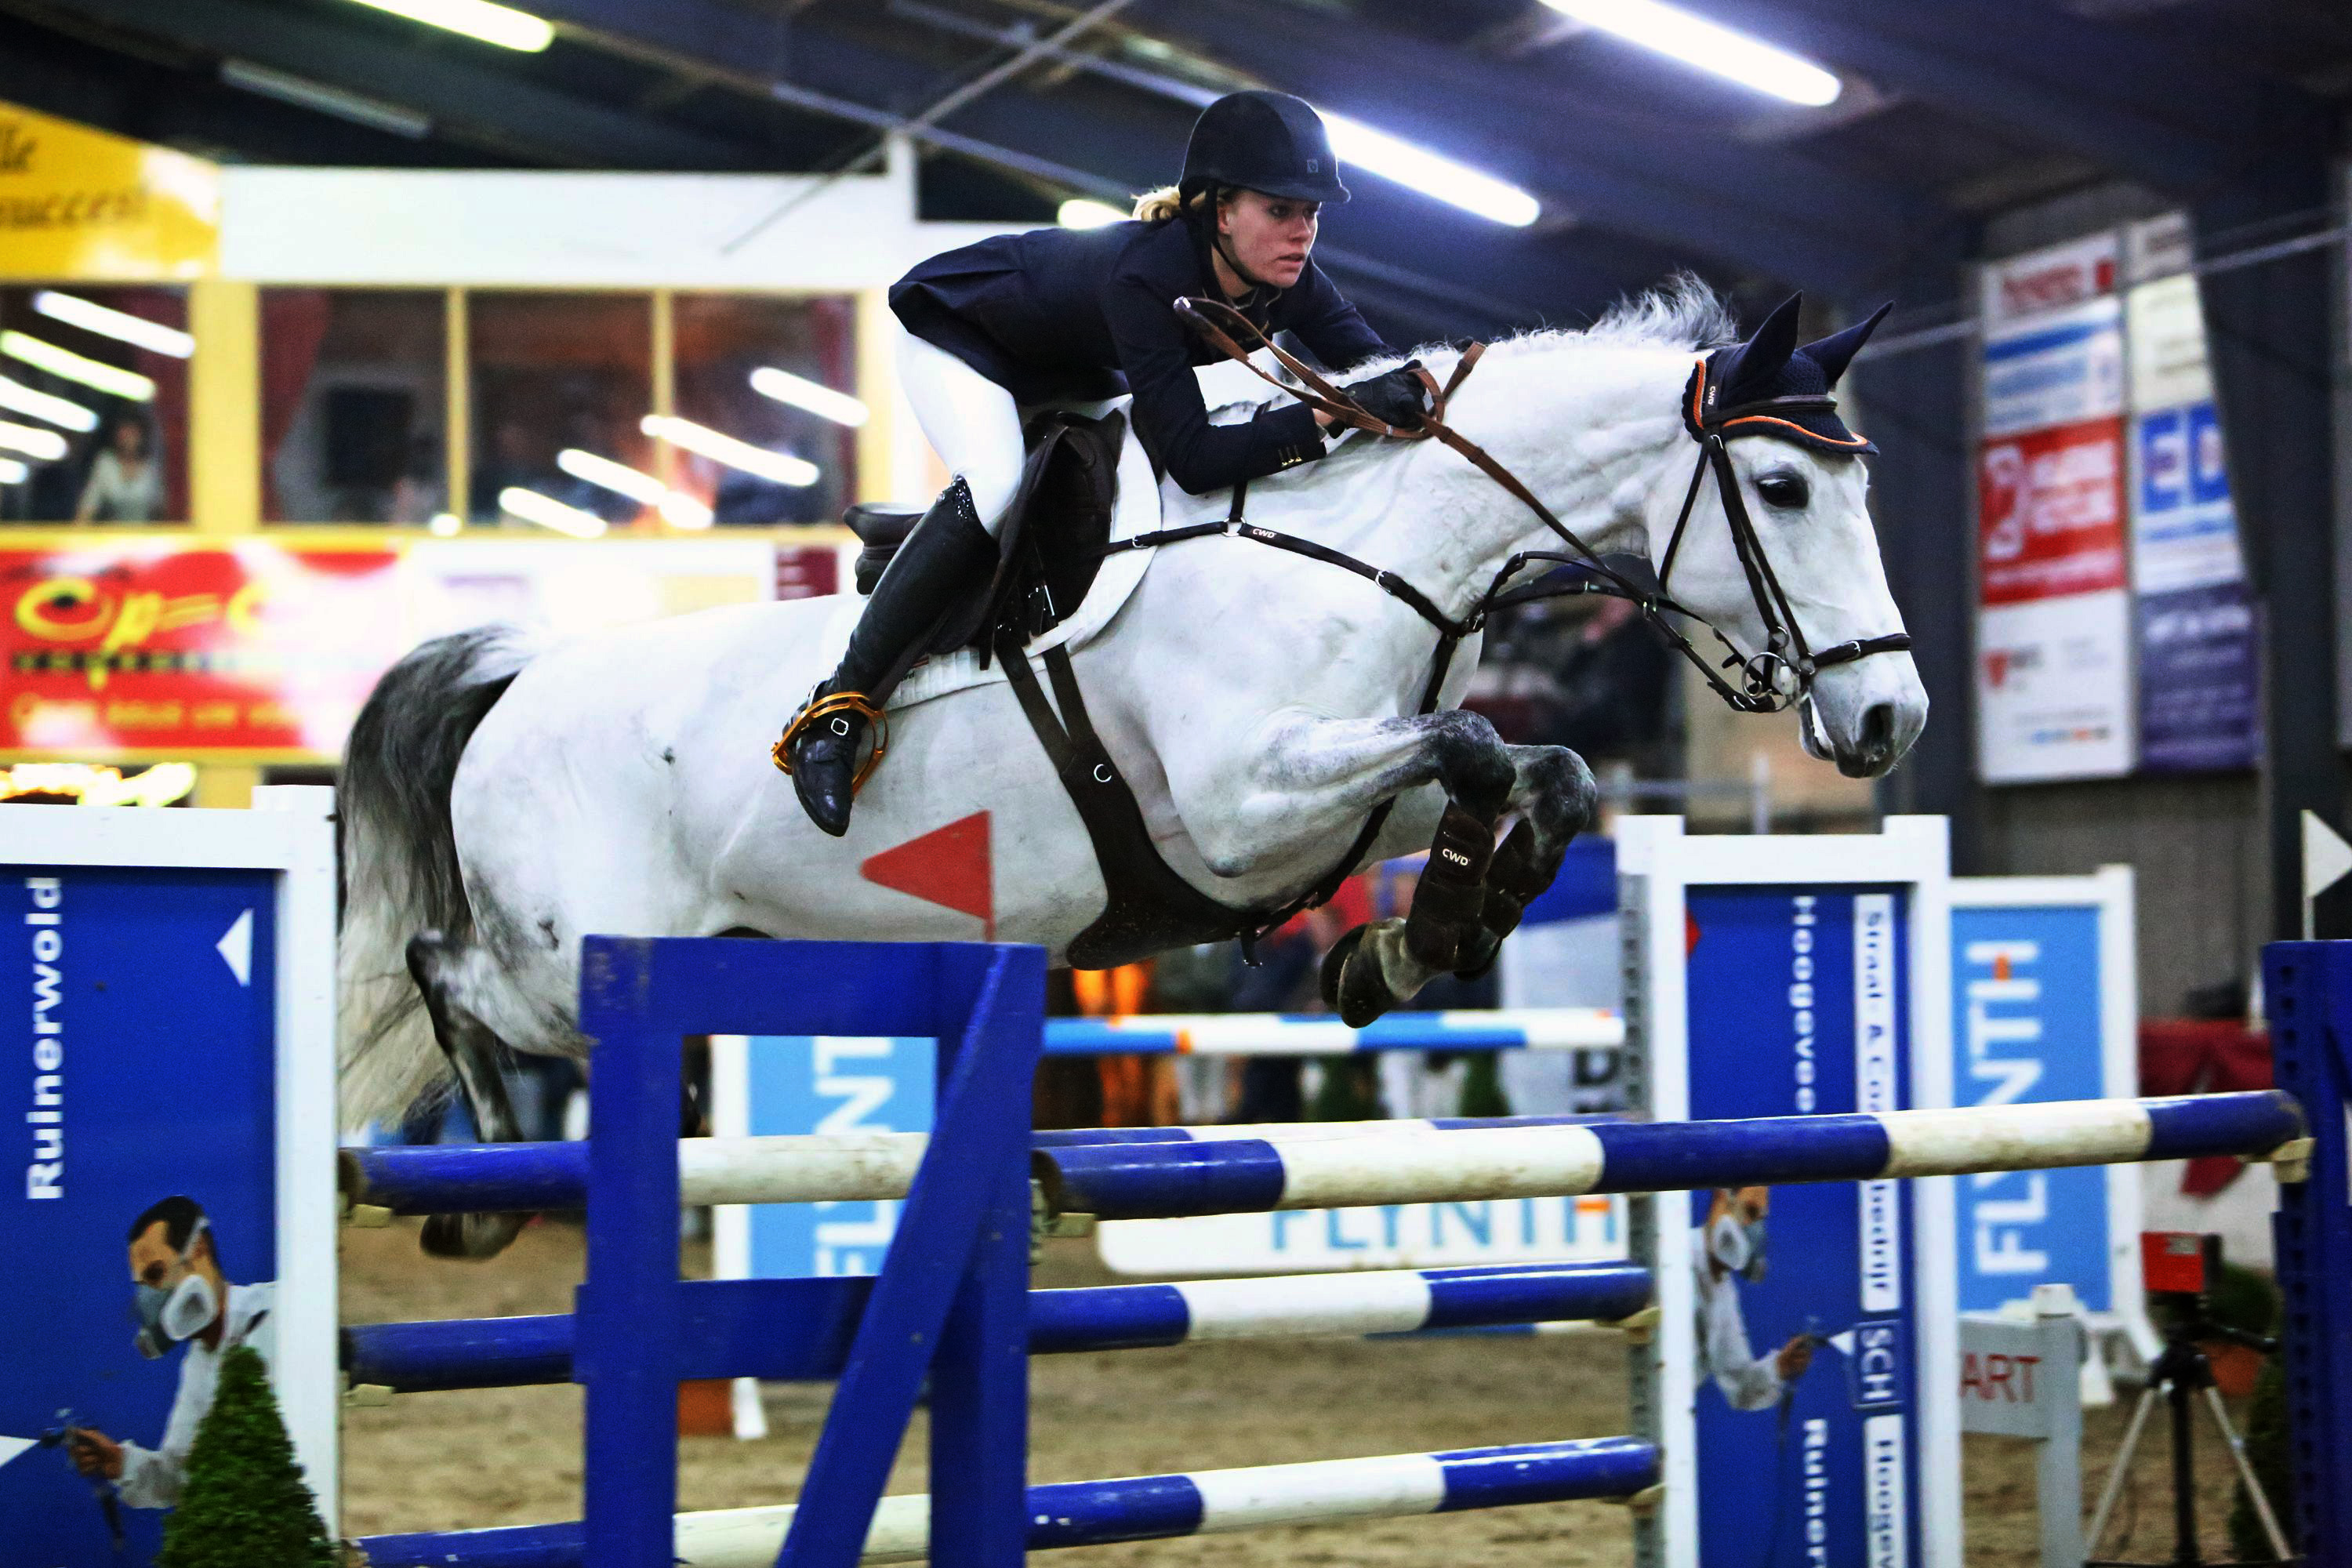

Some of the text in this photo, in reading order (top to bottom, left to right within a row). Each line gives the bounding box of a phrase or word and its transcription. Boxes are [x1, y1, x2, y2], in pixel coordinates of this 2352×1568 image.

[1708, 386, 1716, 405] CWD
[1252, 528, 1277, 539] CWD
[1442, 847, 1469, 867] CWD
[1788, 895, 1817, 1113] Hoogevee
[1965, 941, 2049, 1276] FLNTH
[1860, 1328, 1894, 1400] SCH
[1958, 1352, 2044, 1403] ART
